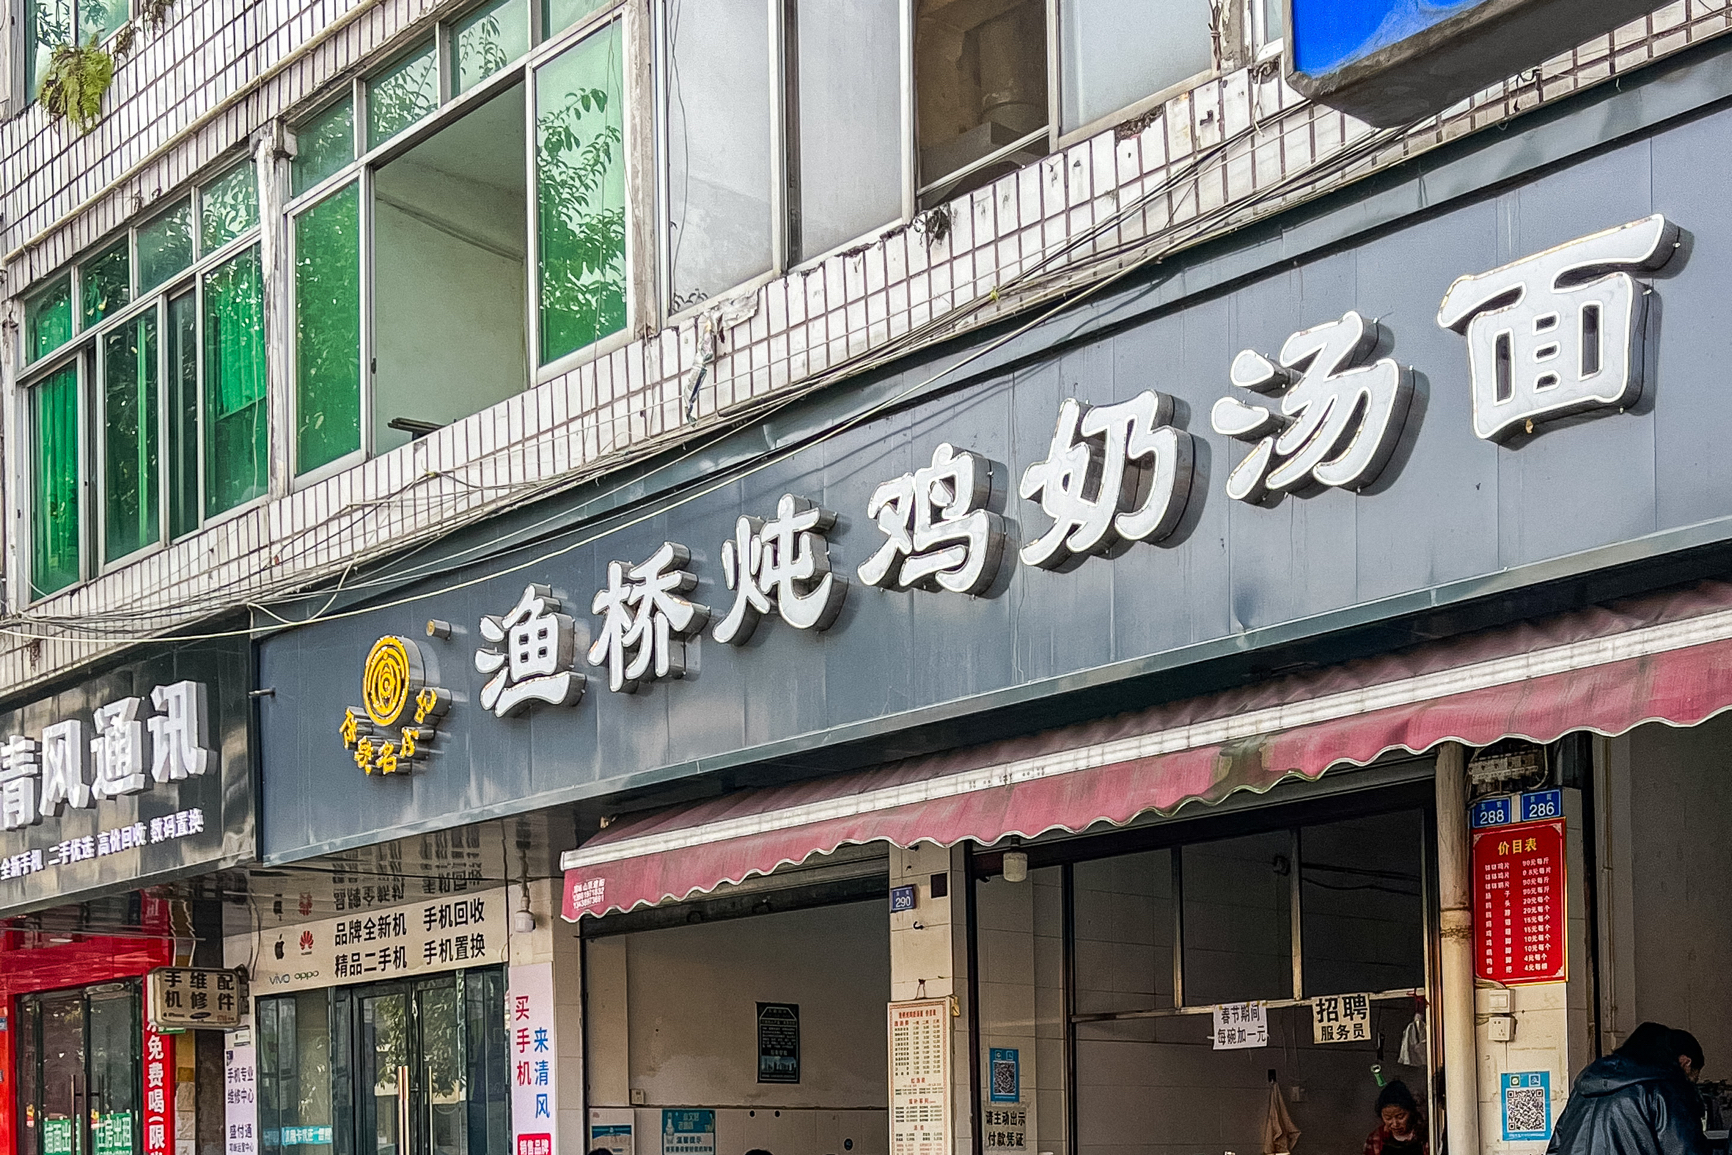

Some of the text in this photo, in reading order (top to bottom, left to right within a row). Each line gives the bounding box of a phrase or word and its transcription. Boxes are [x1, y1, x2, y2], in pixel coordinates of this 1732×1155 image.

[475, 212, 1686, 718] 渔桥炖鸡奶汤面
[0, 680, 207, 831] 清风通讯
[1480, 809, 1504, 824] 288
[1529, 802, 1554, 817] 286
[97, 821, 147, 856] 高价回收
[150, 807, 204, 844] 数码置换
[1498, 837, 1537, 856] 价目表
[895, 896, 911, 908] 290
[335, 898, 485, 946] 品牌全新机 手机回收
[335, 932, 486, 978] 精品二手机 手机置换
[165, 970, 235, 1011] 手机 维修 配件
[1221, 1002, 1261, 1025] 春节期间
[1316, 994, 1368, 1024] 招聘
[516, 995, 532, 1087] 买手机
[1217, 1025, 1267, 1046] 每碗加一元
[1321, 1023, 1366, 1042] 服务员
[534, 1026, 550, 1119] 来清风
[985, 1110, 1026, 1127] 请主动出示
[229, 1123, 253, 1139] 盛付通
[987, 1131, 1024, 1147] 付款凭证
[520, 1139, 549, 1155] 销售品牌
